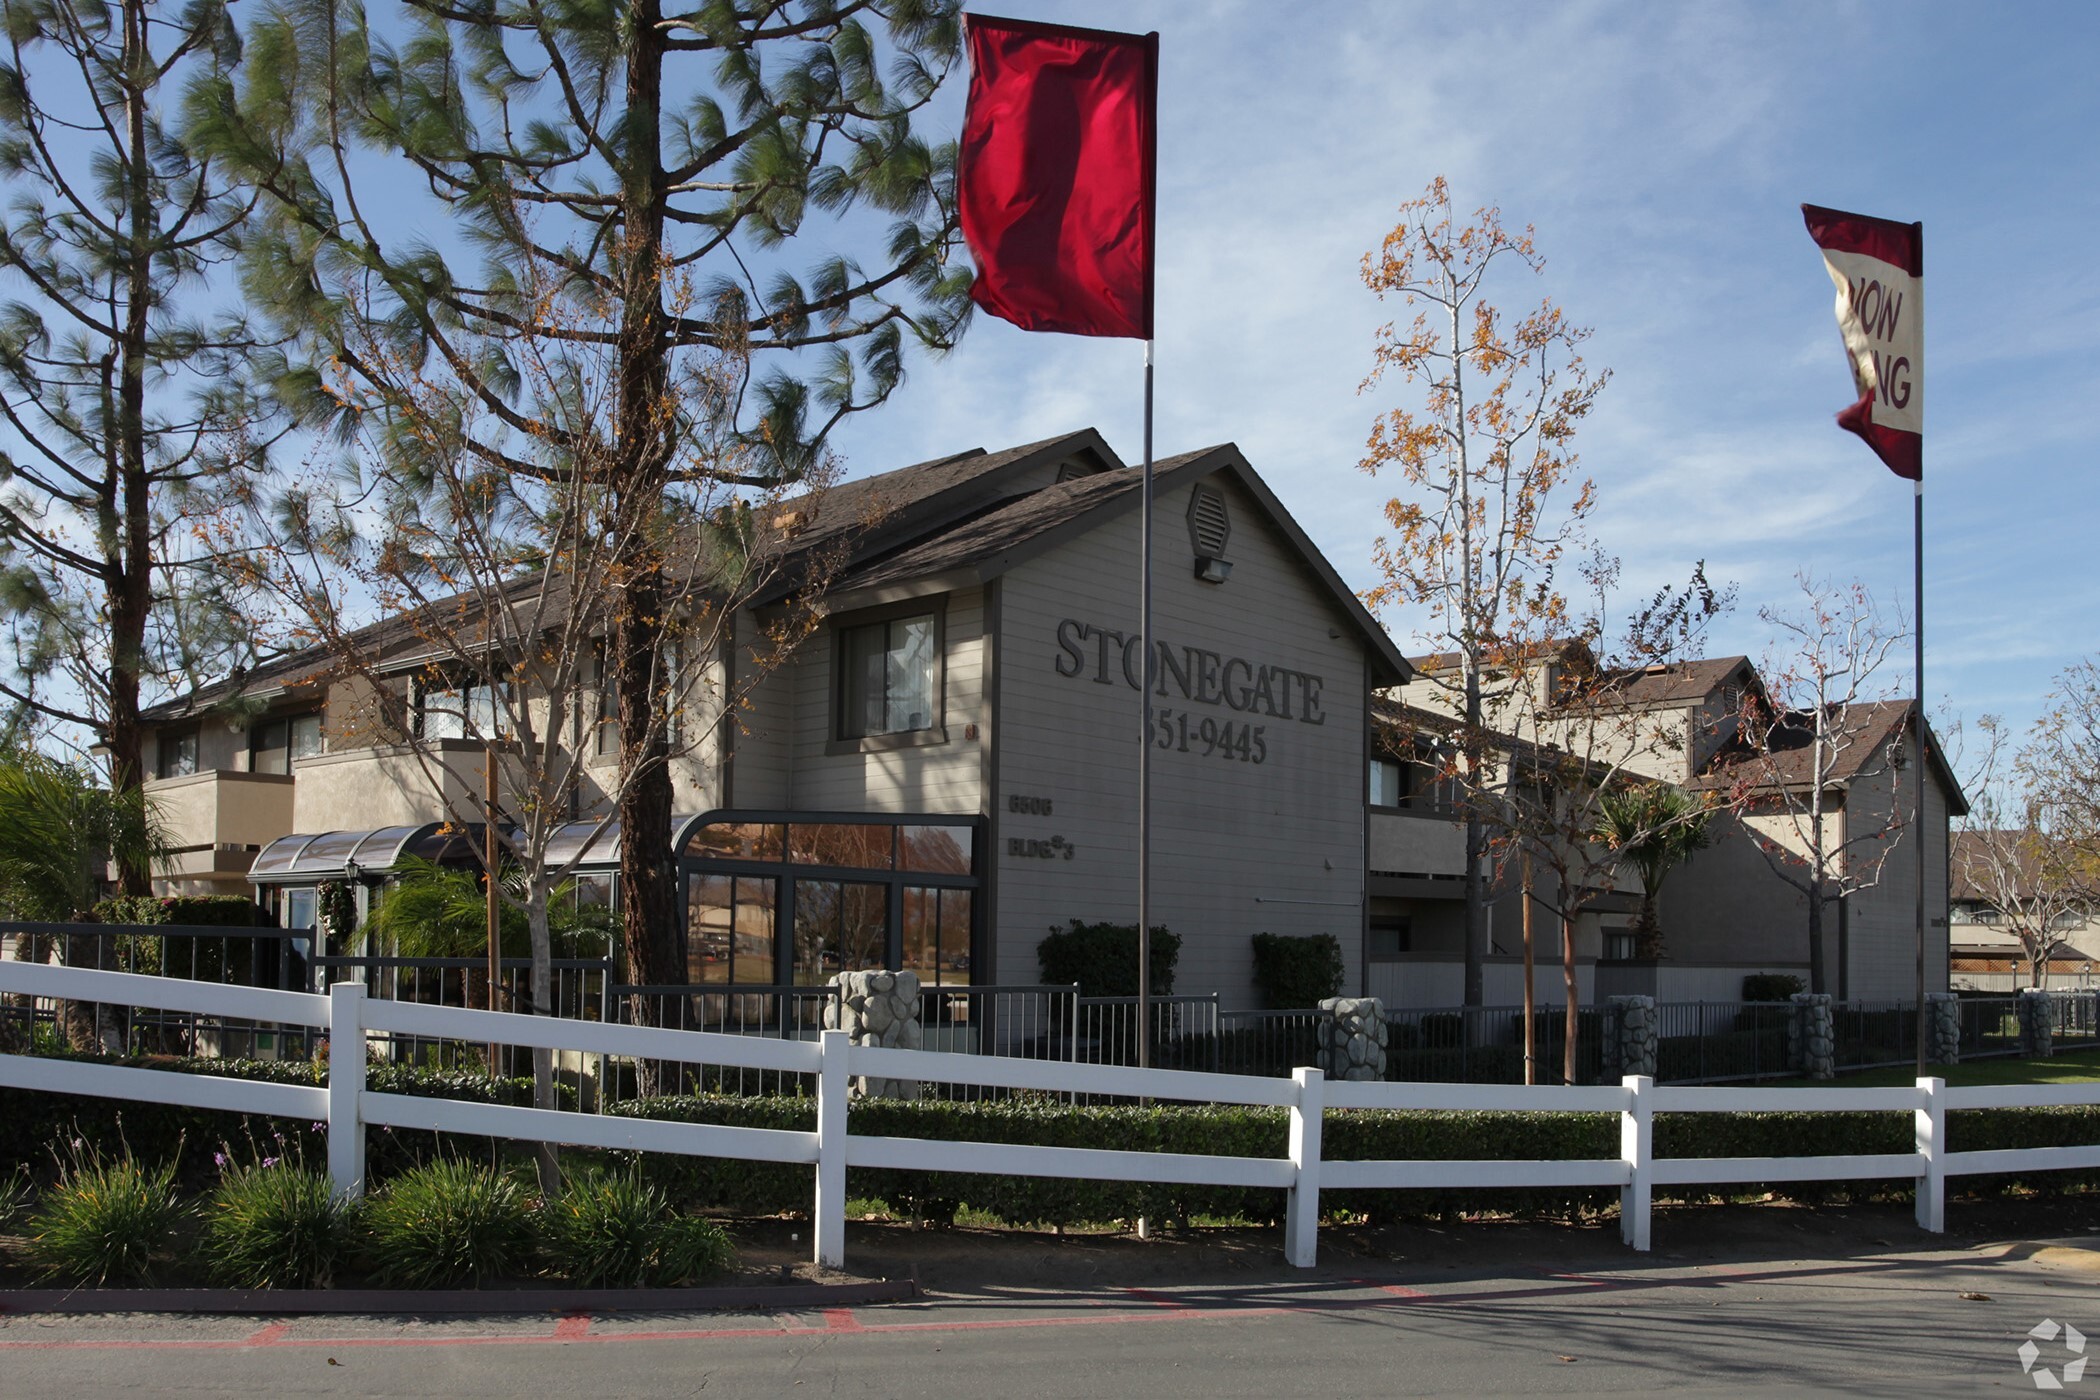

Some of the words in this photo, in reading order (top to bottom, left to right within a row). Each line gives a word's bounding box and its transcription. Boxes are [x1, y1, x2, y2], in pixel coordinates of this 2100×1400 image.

[1848, 276, 1902, 342] NOW
[1871, 350, 1911, 409] NG
[1056, 618, 1326, 725] STONEGATE
